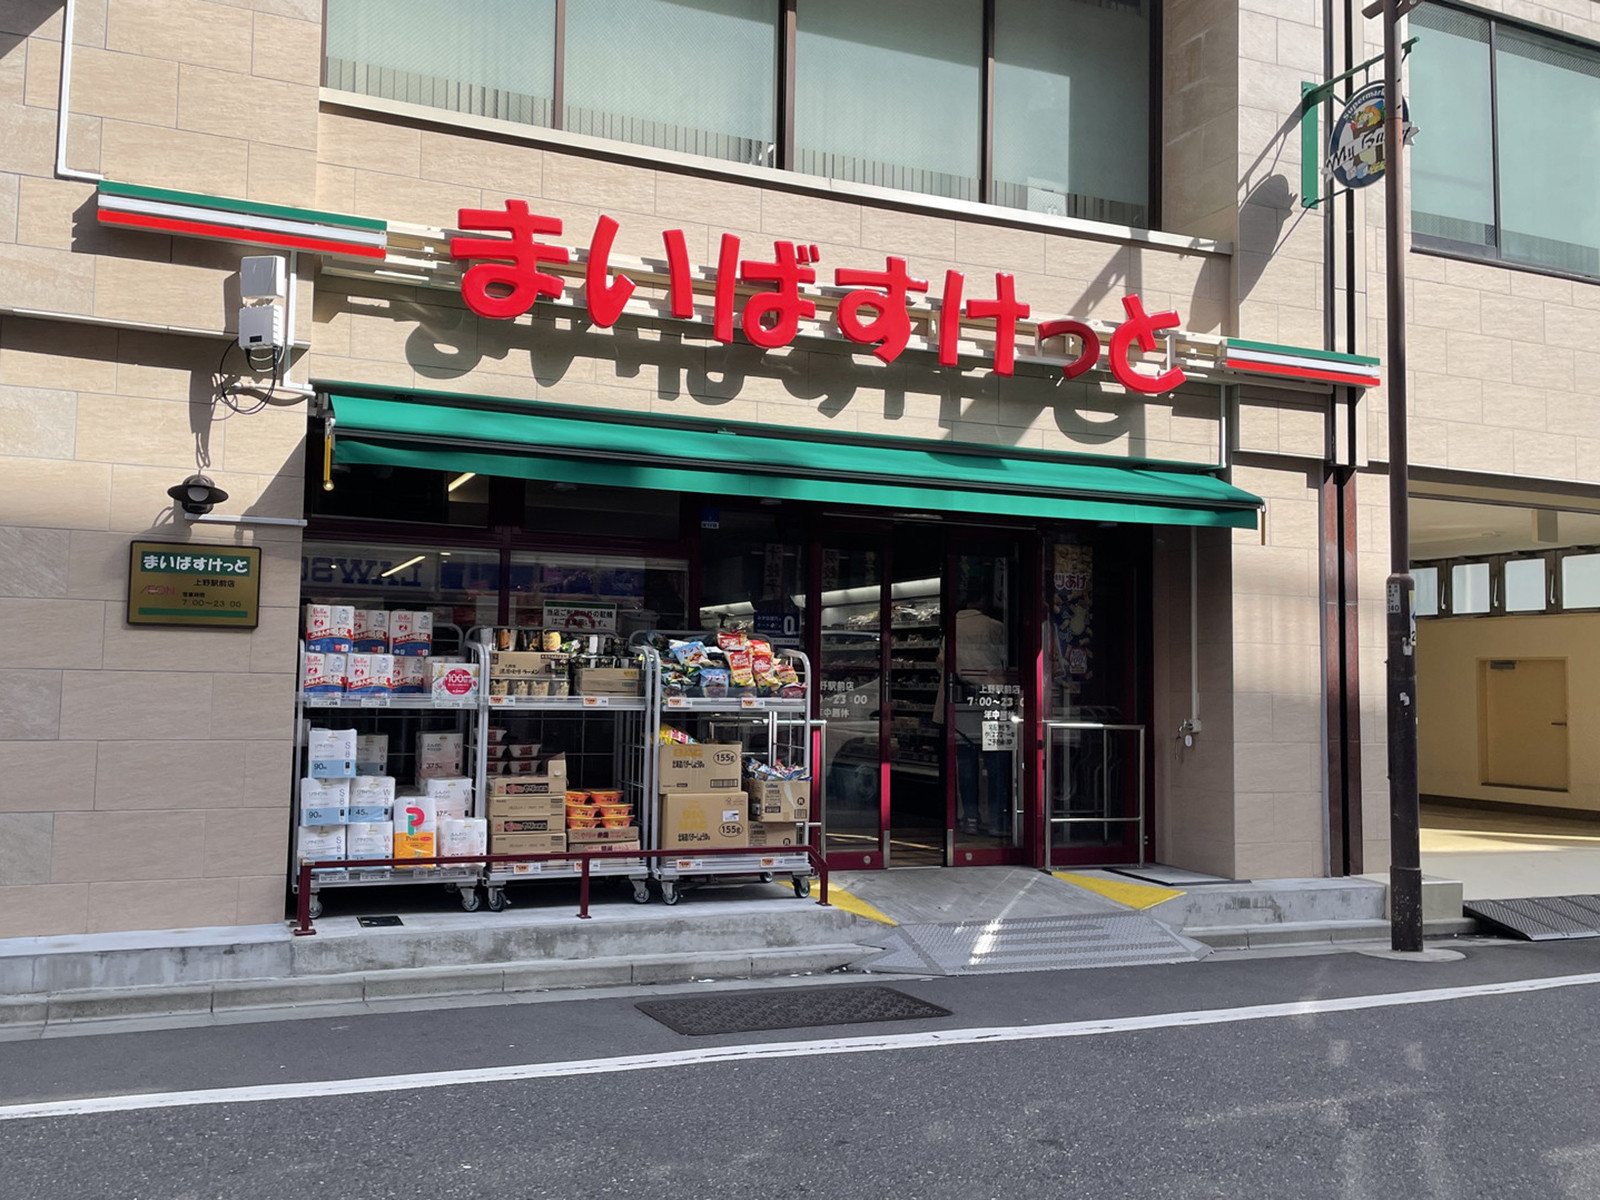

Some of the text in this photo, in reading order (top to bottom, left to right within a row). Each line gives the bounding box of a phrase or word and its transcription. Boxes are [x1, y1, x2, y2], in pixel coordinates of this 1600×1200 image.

[1343, 90, 1386, 121] Supermark
[1326, 145, 1355, 172] My
[450, 199, 1187, 394] まいばすけっと
[143, 555, 248, 574] まいばすけっと
[193, 579, 236, 588] 上野駅前店
[820, 680, 855, 691] 野駅前店
[979, 684, 1021, 694] 上野駅前店
[716, 753, 735, 762] 155g
[721, 826, 741, 834] 155g
